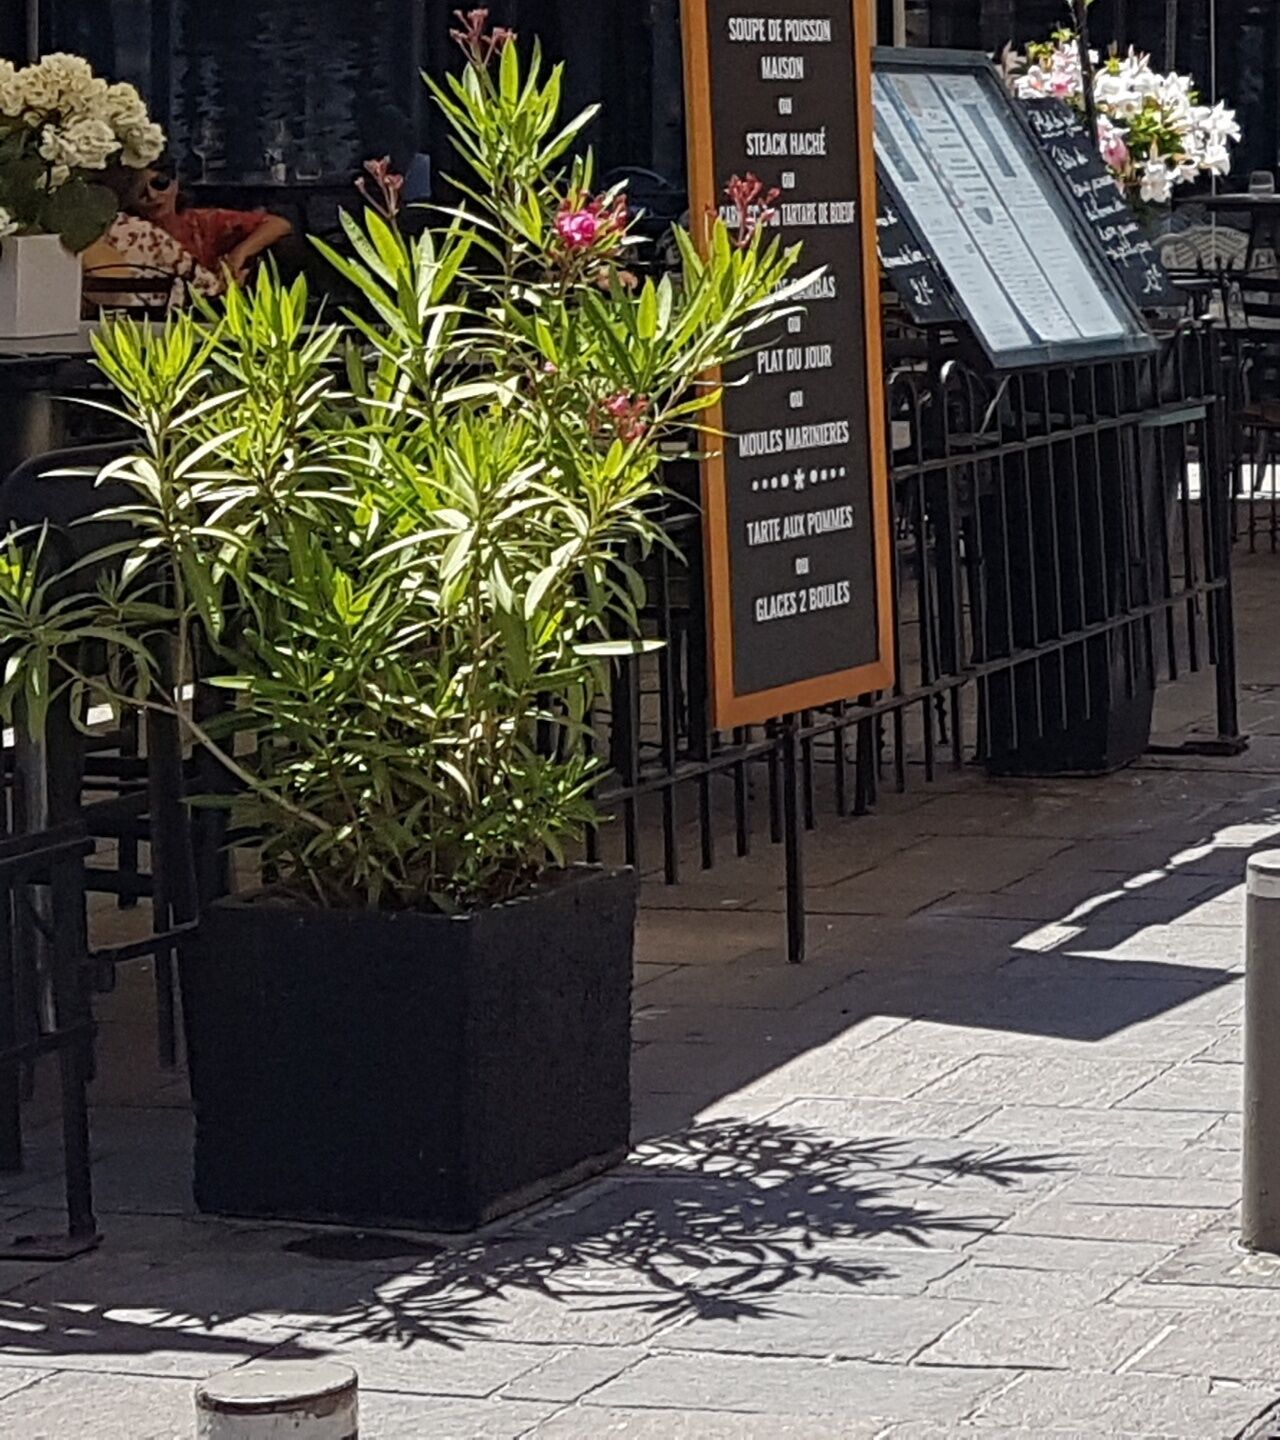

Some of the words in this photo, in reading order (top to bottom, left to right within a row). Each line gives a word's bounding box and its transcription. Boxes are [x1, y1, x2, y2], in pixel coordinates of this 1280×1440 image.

[728, 17, 766, 41] SOUPE
[768, 19, 782, 41] DE
[784, 19, 831, 42] POISSON
[761, 56, 804, 79] MAISON
[746, 133, 788, 155] STEACK
[790, 126, 826, 155] HACHÉ
[781, 203, 817, 226] TARTARE
[818, 202, 829, 224] DE
[829, 201, 855, 224] BOEUF
[757, 348, 783, 374] PLAT
[786, 347, 801, 371] DU
[804, 344, 832, 370] JOUR
[739, 429, 783, 458] MOULES
[747, 517, 781, 546] TARTE
[783, 513, 806, 539] AUX
[807, 505, 853, 536] POMMES
[756, 592, 797, 622] GLACES
[799, 589, 807, 613] 2
[809, 581, 850, 610] BOULES
